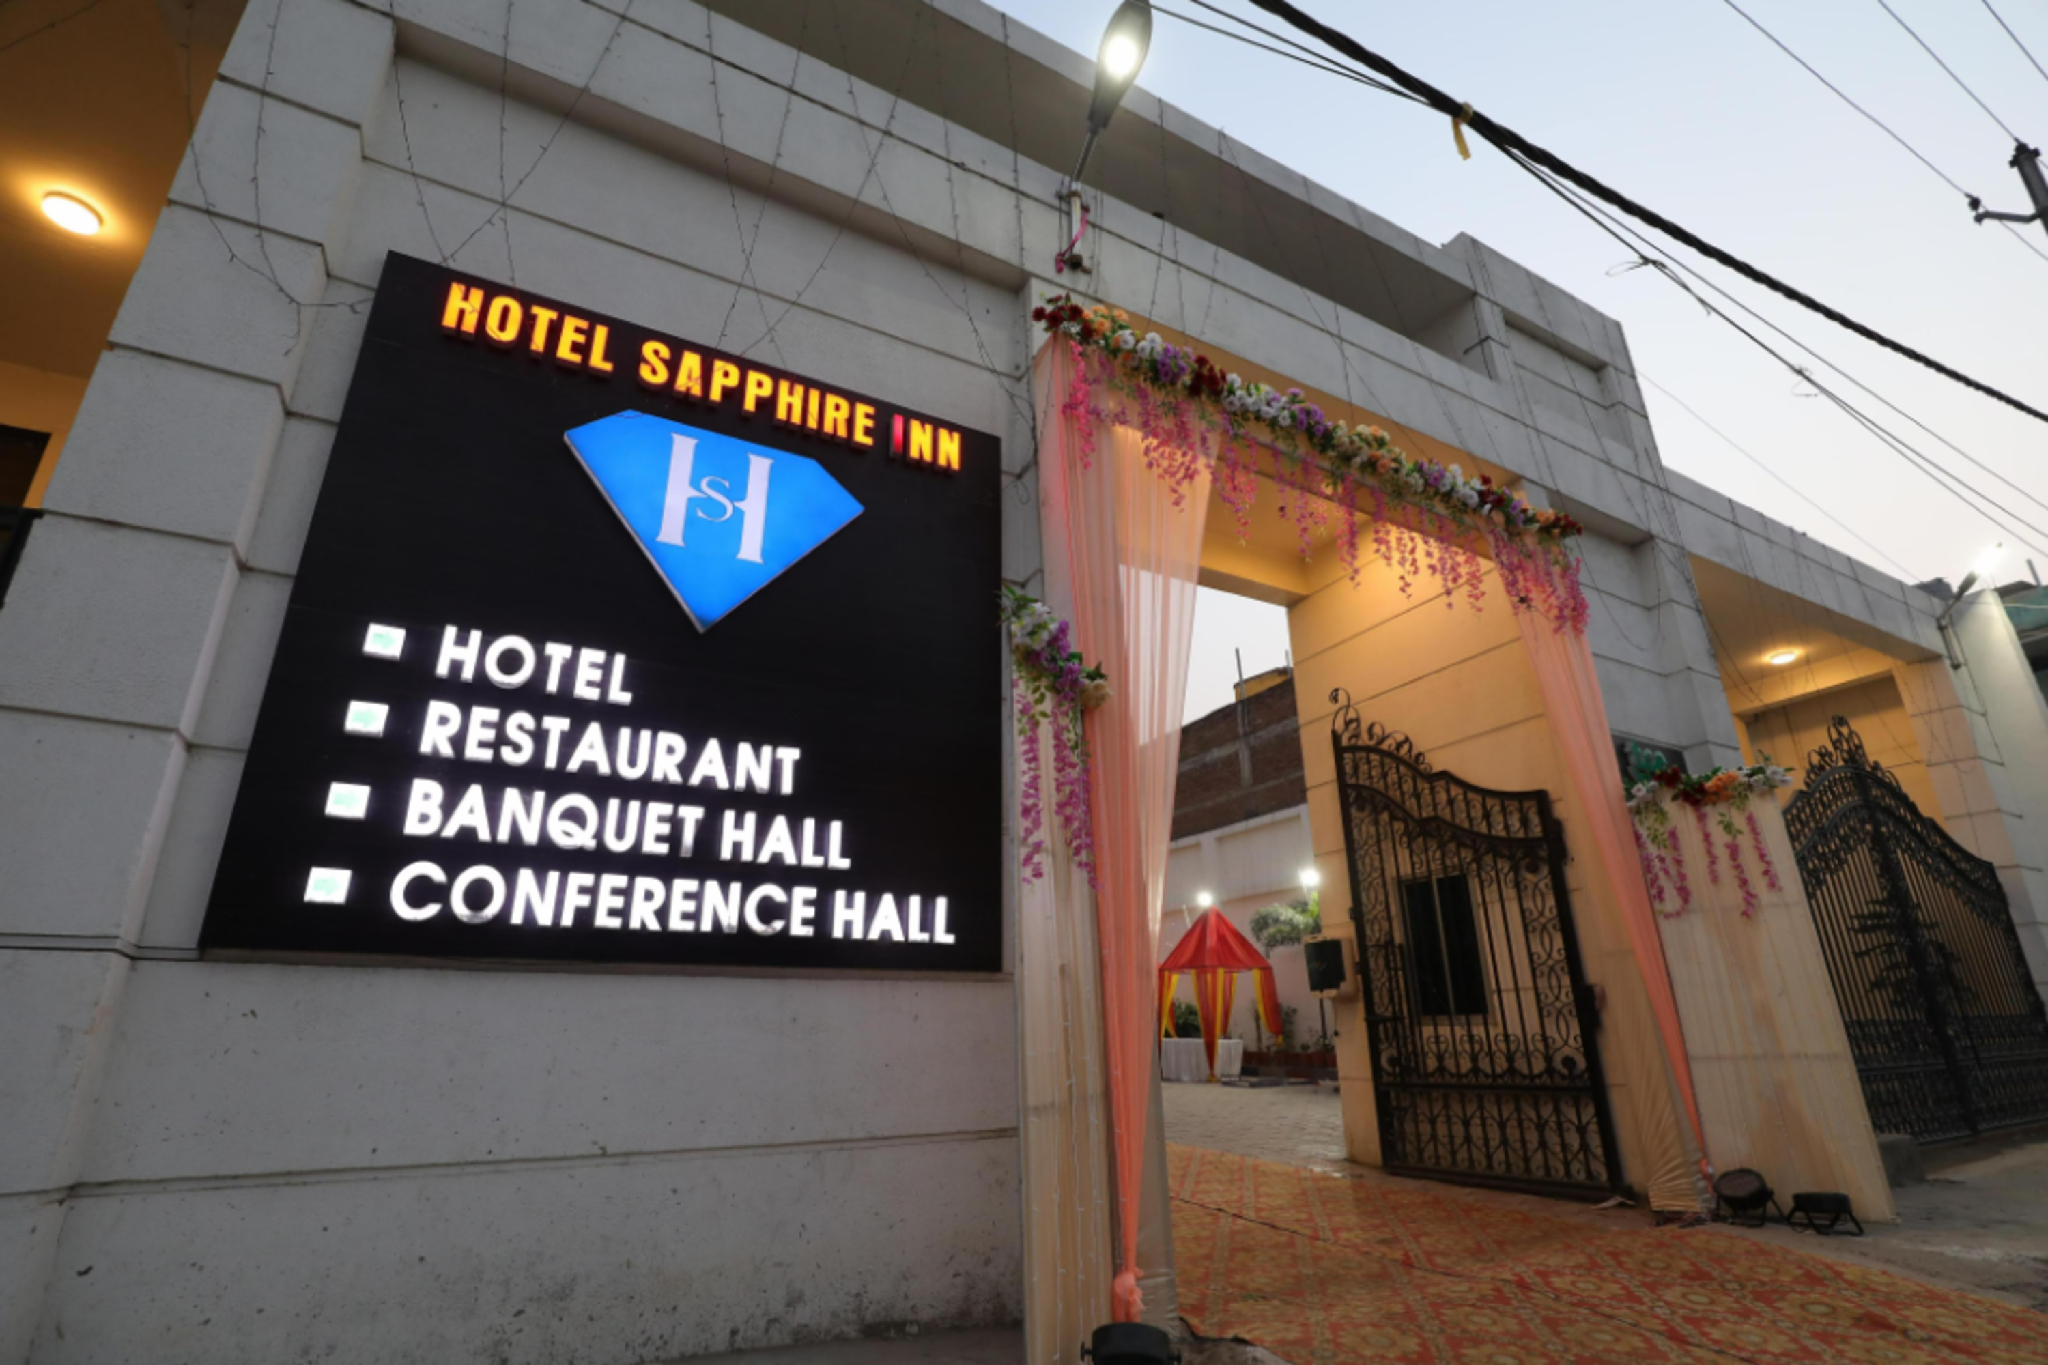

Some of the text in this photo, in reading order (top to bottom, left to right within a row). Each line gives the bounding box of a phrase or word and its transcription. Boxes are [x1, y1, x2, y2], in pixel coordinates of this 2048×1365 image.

[441, 281, 962, 471] HOTEL SAPPHIRE INN
[435, 625, 633, 705] HOTEL
[418, 700, 801, 795] RESTAURANT
[402, 778, 852, 869] BANQUET HALL
[389, 860, 956, 944] CONFERENCE HALL
